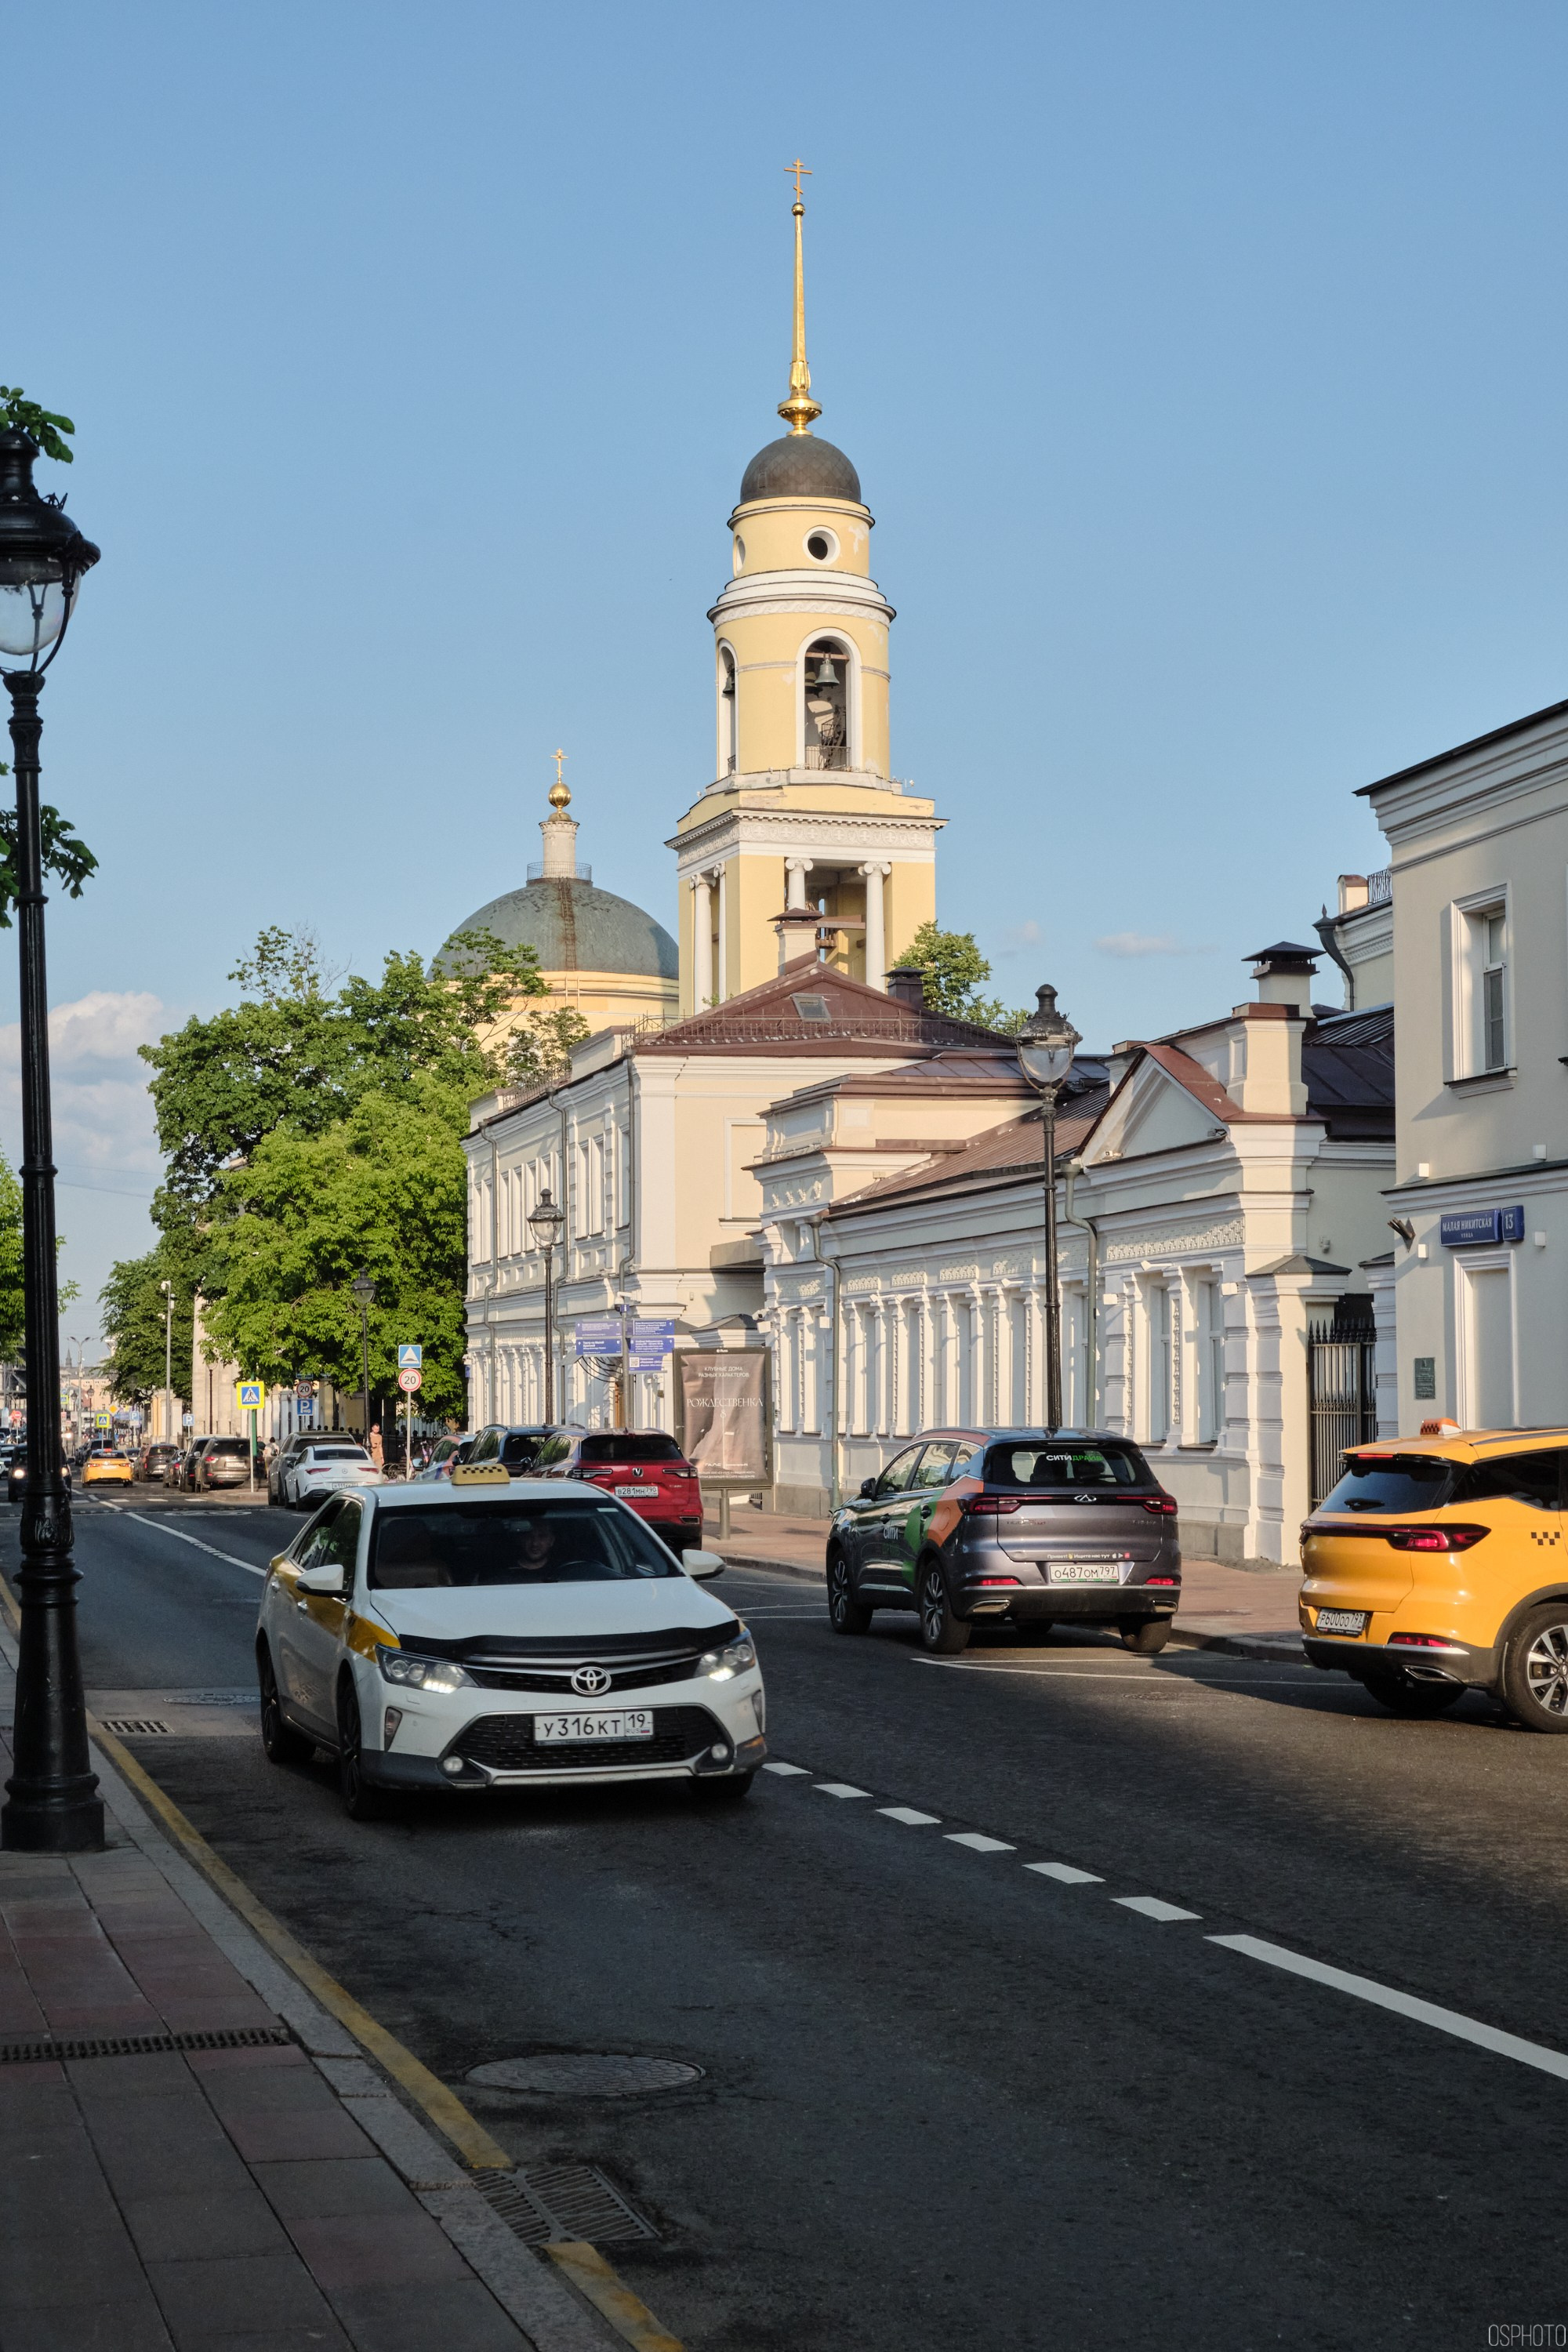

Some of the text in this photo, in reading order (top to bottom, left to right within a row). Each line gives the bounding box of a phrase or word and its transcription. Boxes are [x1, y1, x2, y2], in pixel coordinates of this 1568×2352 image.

[1443, 1217, 1493, 1232] МАЛАЯ НИКИТСКАЯ
[1504, 1213, 1514, 1230] 13
[404, 1376, 416, 1385] 20
[687, 1397, 764, 1408] РОЖДЕСТВЕНКА
[720, 1409, 727, 1418] 8
[1054, 1566, 1115, 1579] О487ОМ 797
[1351, 1613, 1363, 1624] 797
[543, 1713, 645, 1737] У316КТ 19
